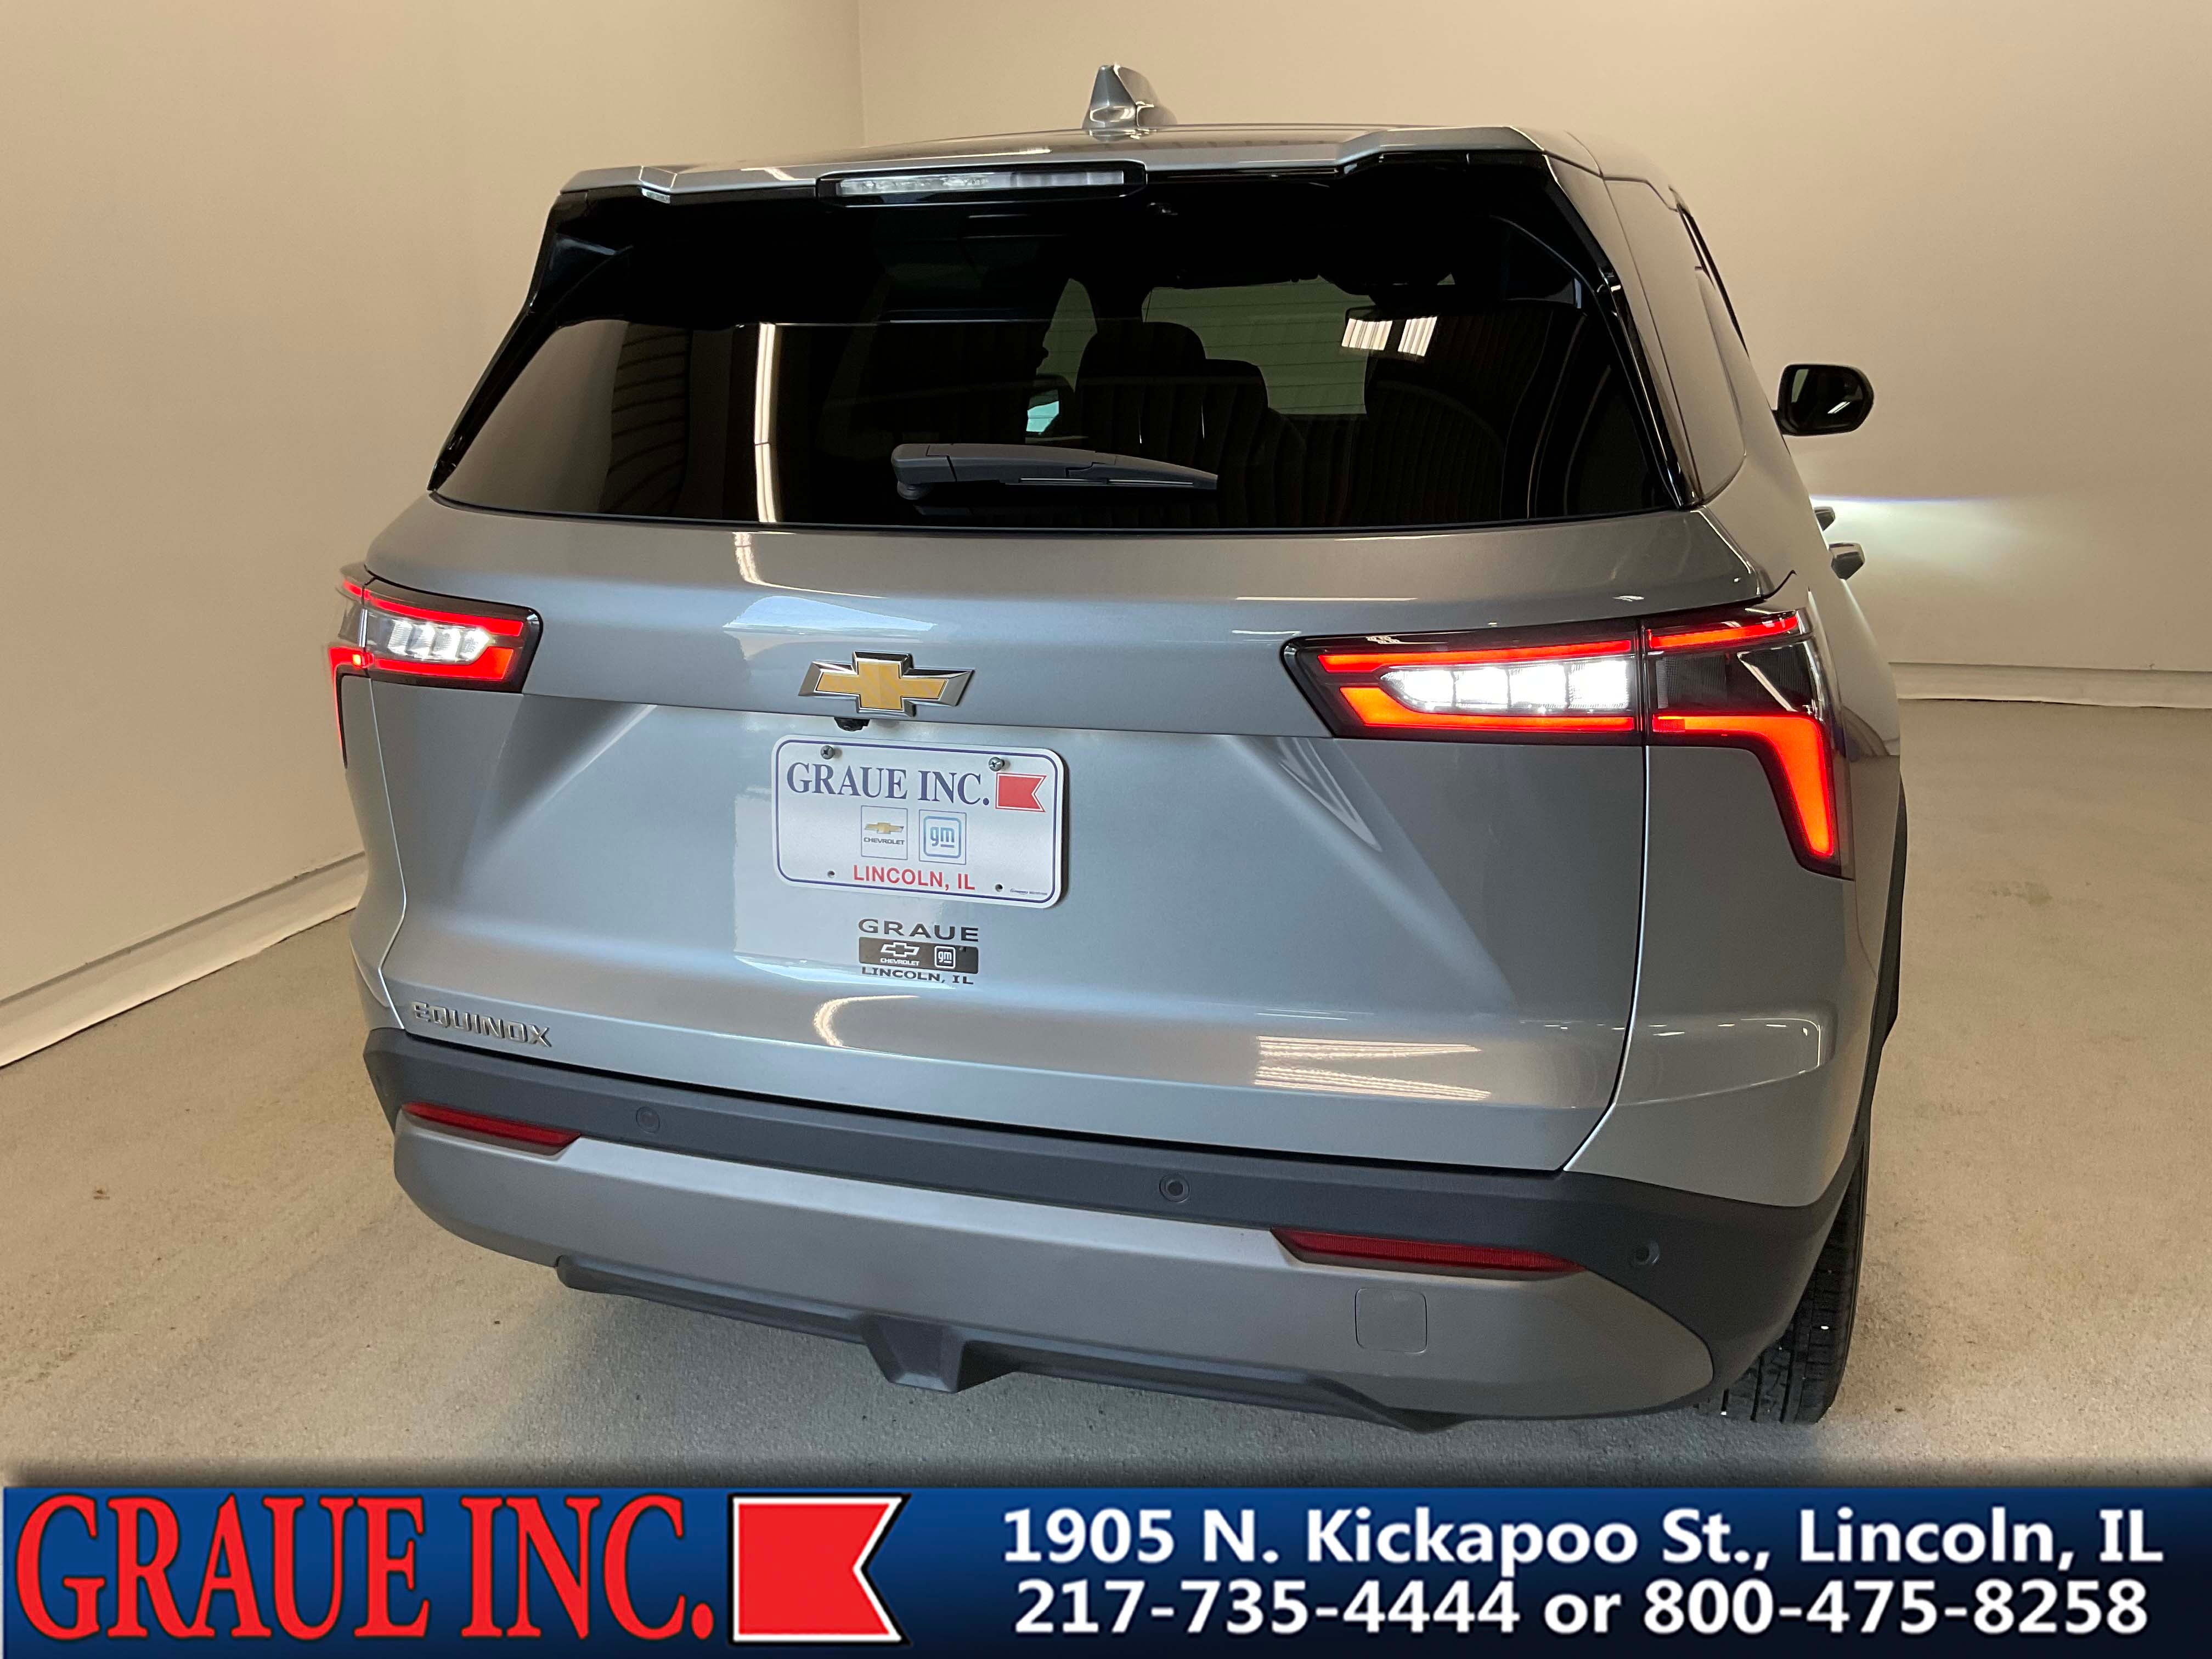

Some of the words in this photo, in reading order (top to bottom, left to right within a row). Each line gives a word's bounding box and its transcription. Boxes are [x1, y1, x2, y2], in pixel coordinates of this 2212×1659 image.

[787, 761, 908, 800] GRAUE
[917, 770, 990, 806] INC.
[864, 837, 905, 845] CHEVROLET
[930, 826, 955, 847] gm
[853, 865, 950, 891] LINCOLN,
[957, 873, 976, 890] IL
[858, 918, 979, 942] GRAUE
[880, 957, 920, 966] CHEVROLET
[938, 951, 952, 963] gm
[862, 966, 945, 983] LINCOLN,
[952, 974, 974, 985] IL
[413, 1000, 552, 1047] EQUINOX
